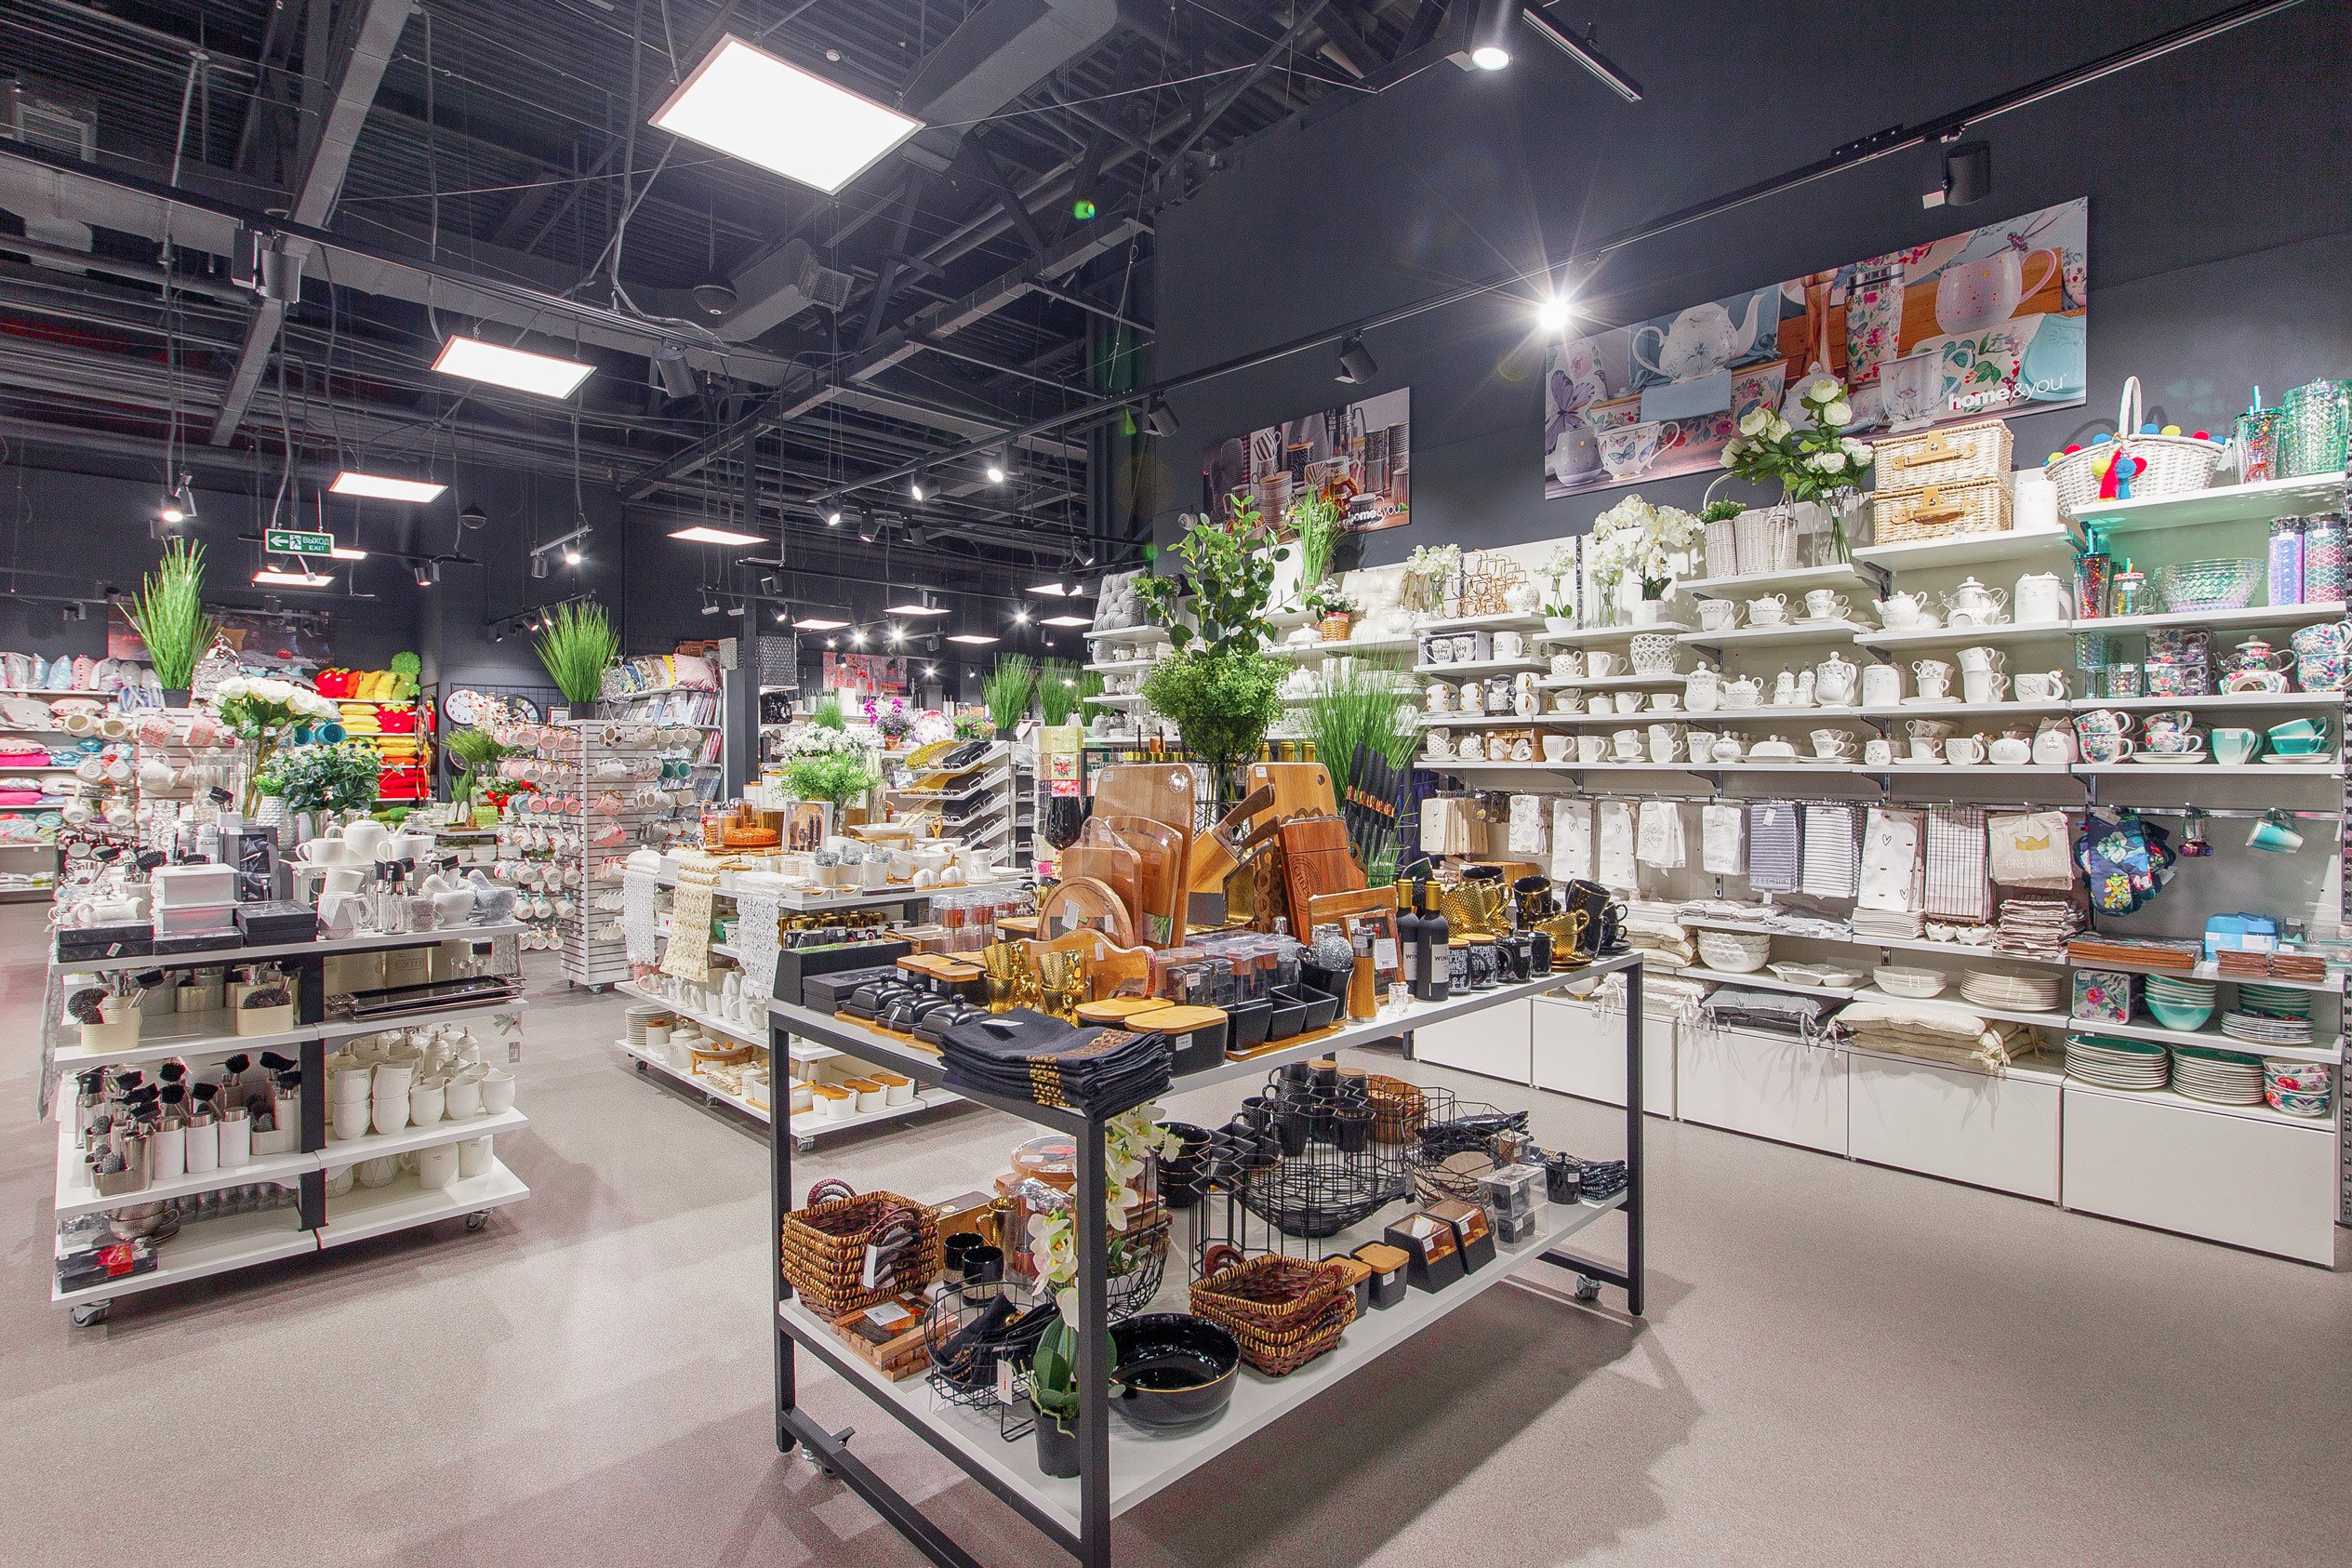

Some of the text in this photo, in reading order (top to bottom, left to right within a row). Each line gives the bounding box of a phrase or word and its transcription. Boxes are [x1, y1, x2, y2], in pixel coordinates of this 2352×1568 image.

[1948, 377, 2063, 410] home&you
[1348, 503, 1401, 524] home&you
[302, 536, 330, 546] ВЫХОД
[2005, 854, 2062, 869] ONE & ONLY
[396, 960, 423, 969] COFFEE
